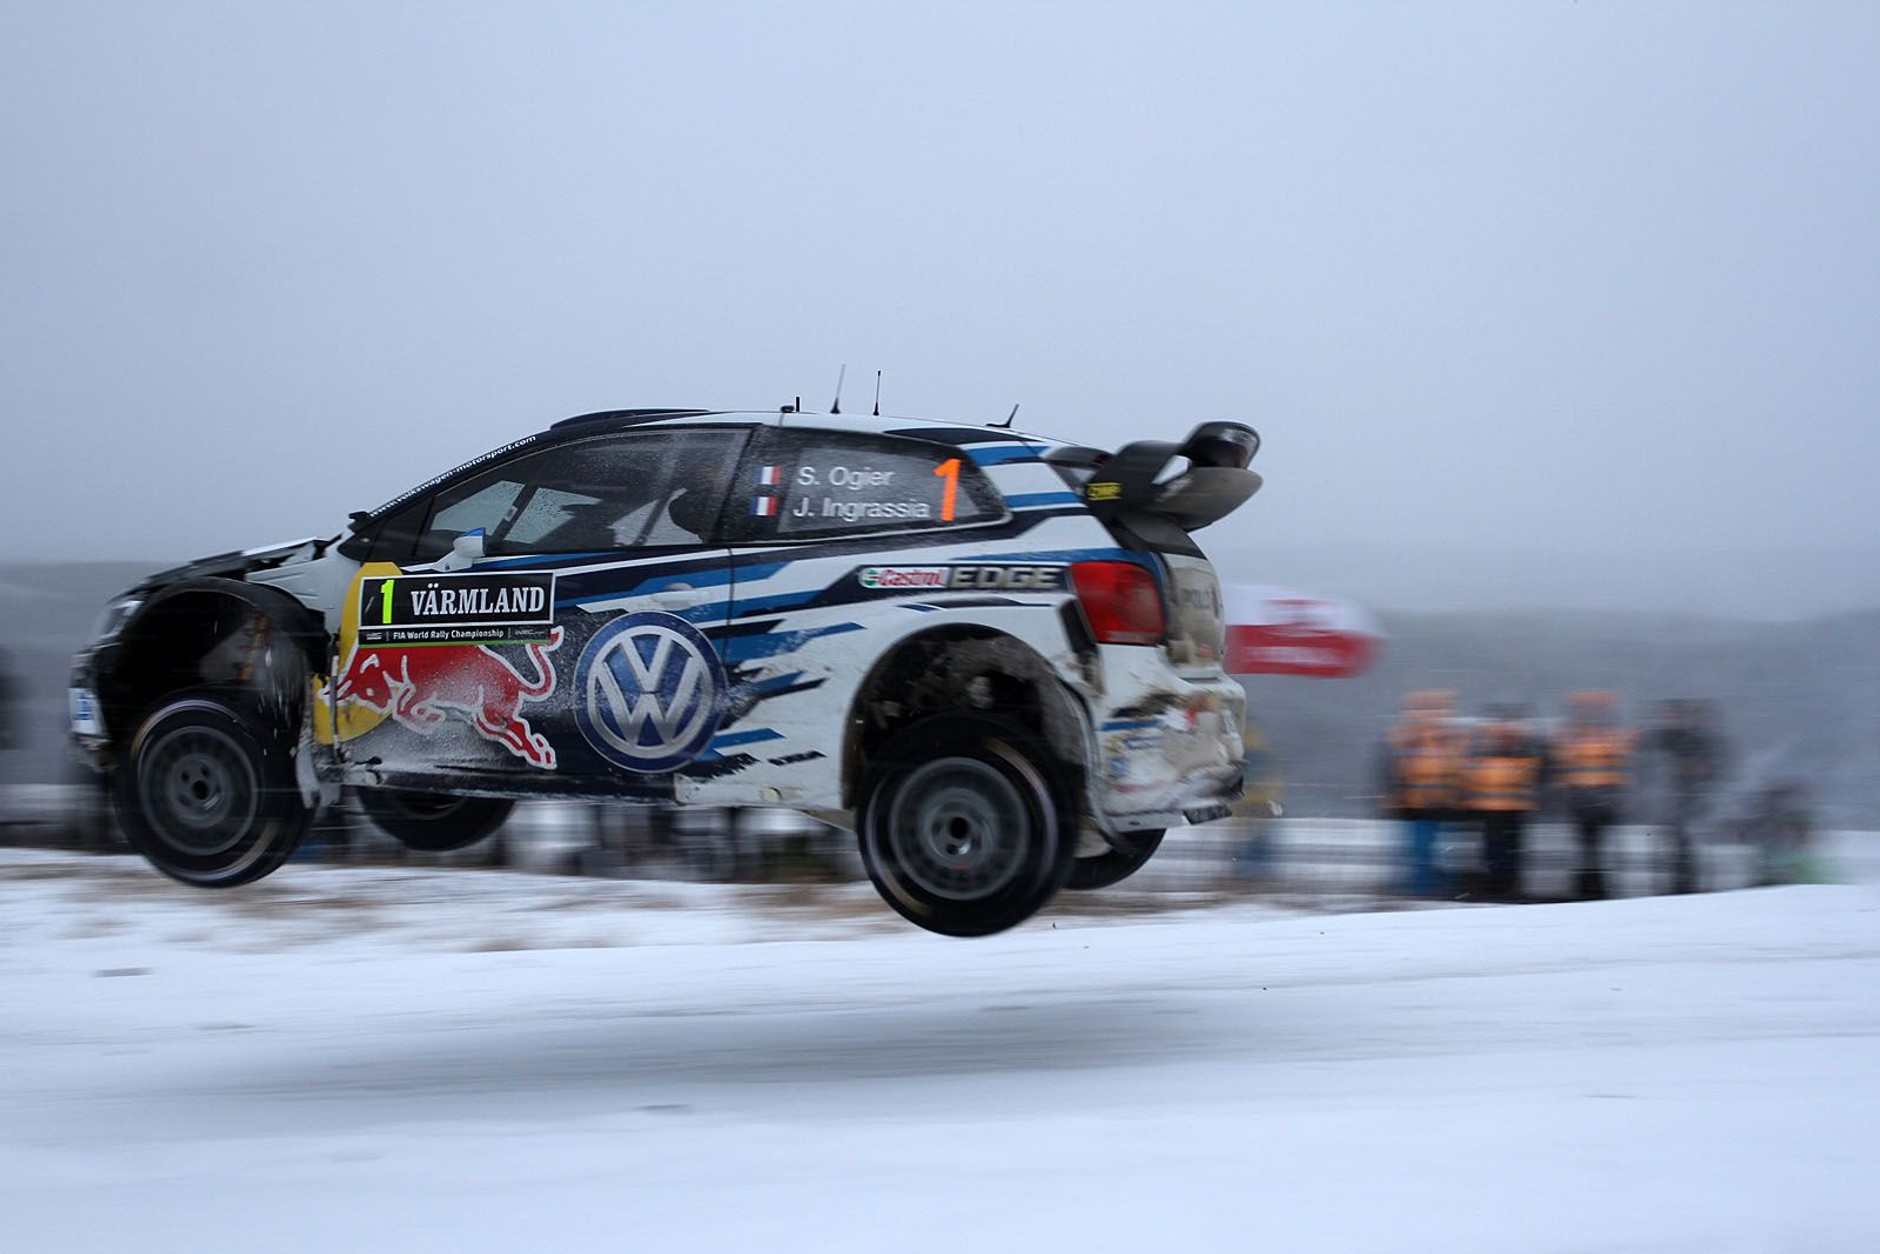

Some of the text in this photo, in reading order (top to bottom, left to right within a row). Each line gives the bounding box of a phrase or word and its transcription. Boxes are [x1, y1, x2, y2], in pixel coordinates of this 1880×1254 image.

[797, 466, 895, 490] S. Ogier
[933, 458, 961, 521] 1
[793, 497, 931, 522] J. Ingrassia
[880, 567, 1062, 588] Castrol EDGE
[380, 579, 395, 624] 1
[410, 583, 545, 616] VÄRMLAND
[393, 631, 406, 640] FIA
[407, 631, 429, 640] World
[430, 630, 450, 641] Rally
[451, 628, 504, 639] Championship
